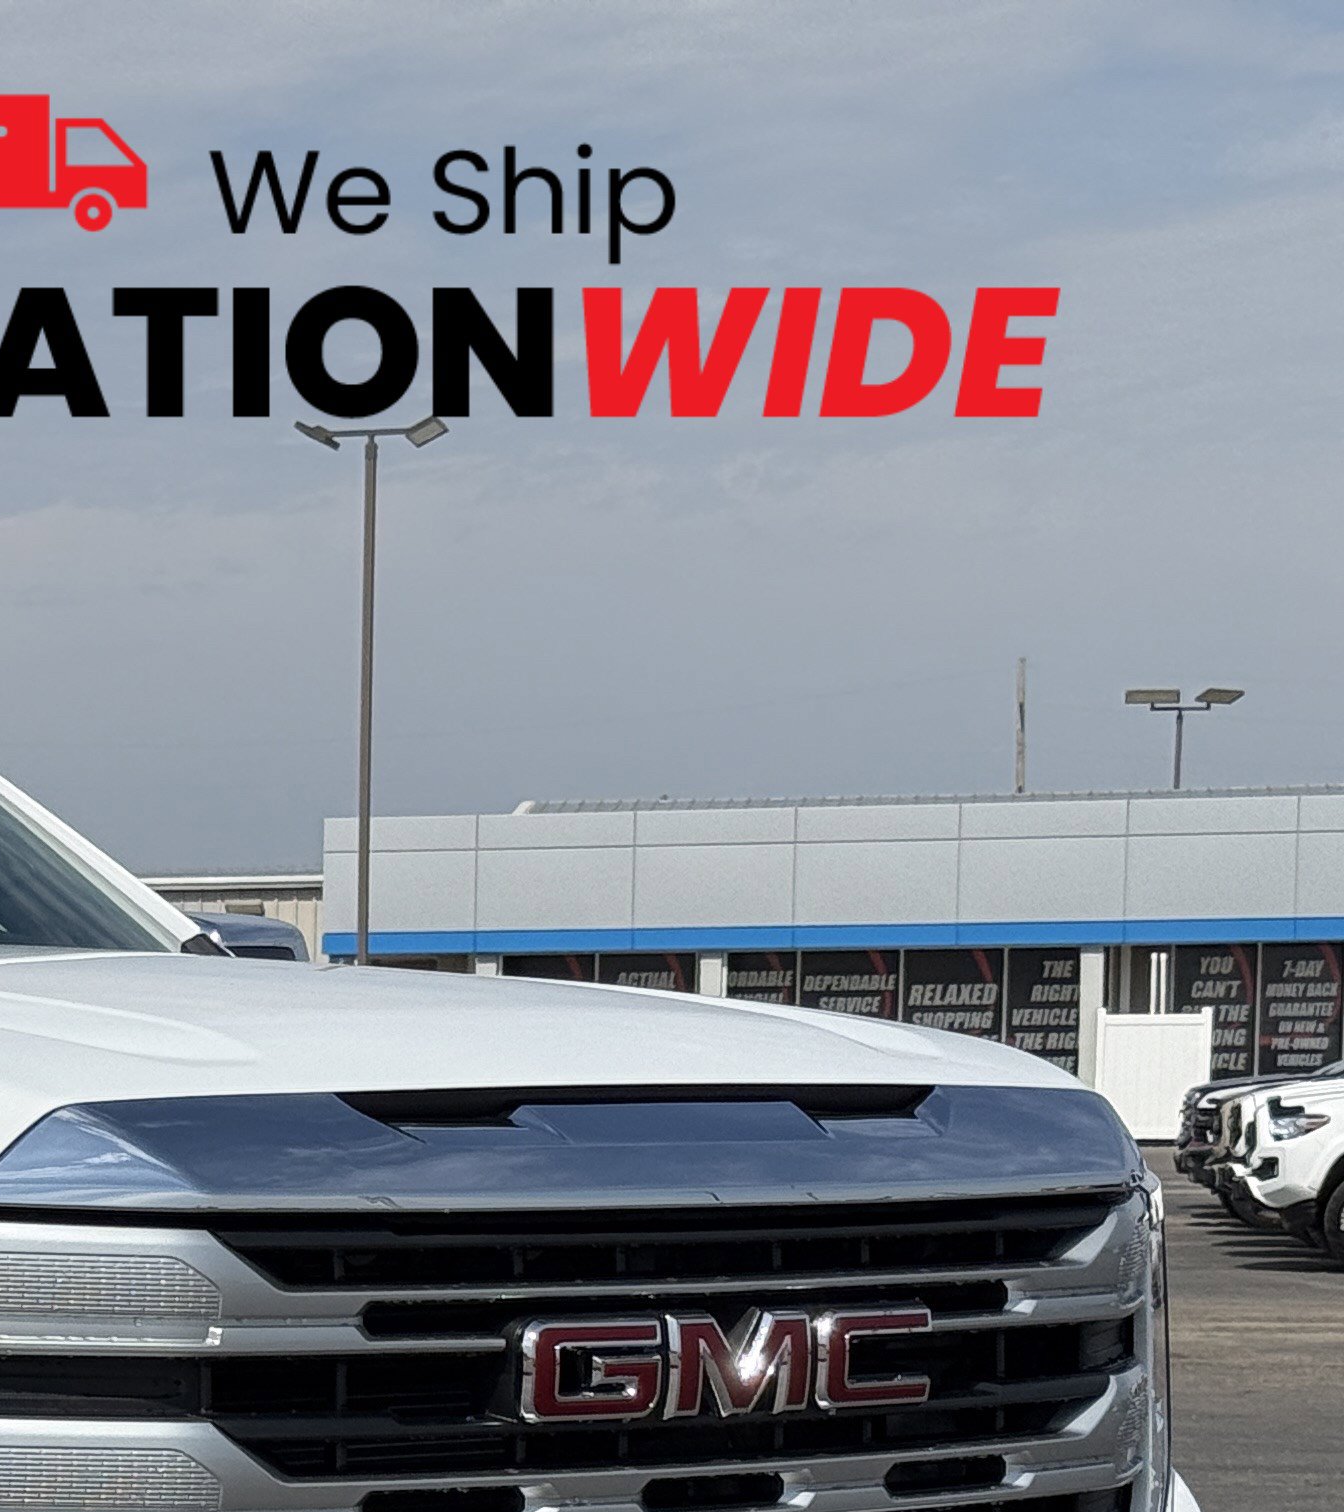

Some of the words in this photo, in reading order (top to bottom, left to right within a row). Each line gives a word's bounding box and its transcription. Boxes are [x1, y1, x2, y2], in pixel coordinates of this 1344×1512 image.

[1042, 960, 1075, 979] THE
[1200, 956, 1235, 975] YOU
[1282, 959, 1325, 978] 7-DAY
[803, 974, 898, 992] DEPENDABLE
[1191, 980, 1242, 999] CAN'T
[1265, 983, 1305, 998] MONEY
[908, 983, 999, 1007] RELAXED
[1030, 984, 1080, 1002] RIGHT
[819, 996, 882, 1014] SERVICE
[1218, 1004, 1251, 1023] THE
[1269, 1002, 1336, 1018] GUARANTEE
[912, 1011, 994, 1029] SHOPPING
[1012, 1008, 1077, 1027] VEHICLE
[1014, 1032, 1044, 1051] THE
[1045, 1032, 1076, 1050] RIG
[1213, 1028, 1247, 1047] ONG
[518, 1304, 931, 1424] GMC
